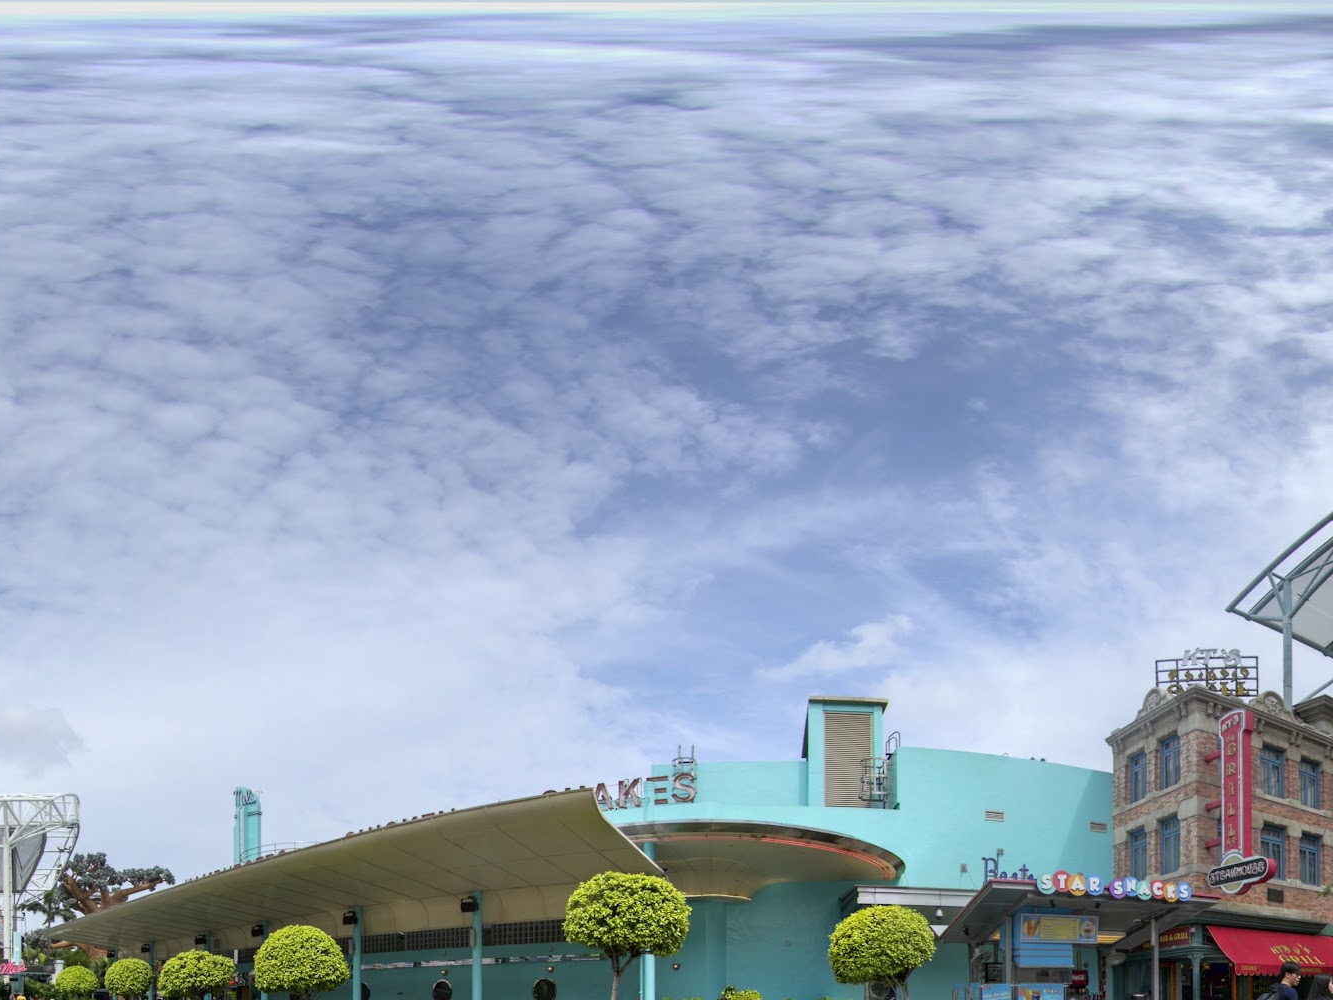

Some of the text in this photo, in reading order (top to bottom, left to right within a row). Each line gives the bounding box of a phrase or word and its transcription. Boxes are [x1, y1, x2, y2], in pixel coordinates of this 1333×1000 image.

[1226, 742, 1236, 838] GRILL
[1209, 861, 1265, 884] STEAKHOUSE
[1041, 874, 1100, 892] STAR
[1113, 877, 1189, 899] SNACKS
[1160, 935, 1168, 943] BAR
[1174, 932, 1189, 940] GRILL
[1279, 954, 1325, 965] GRILL
